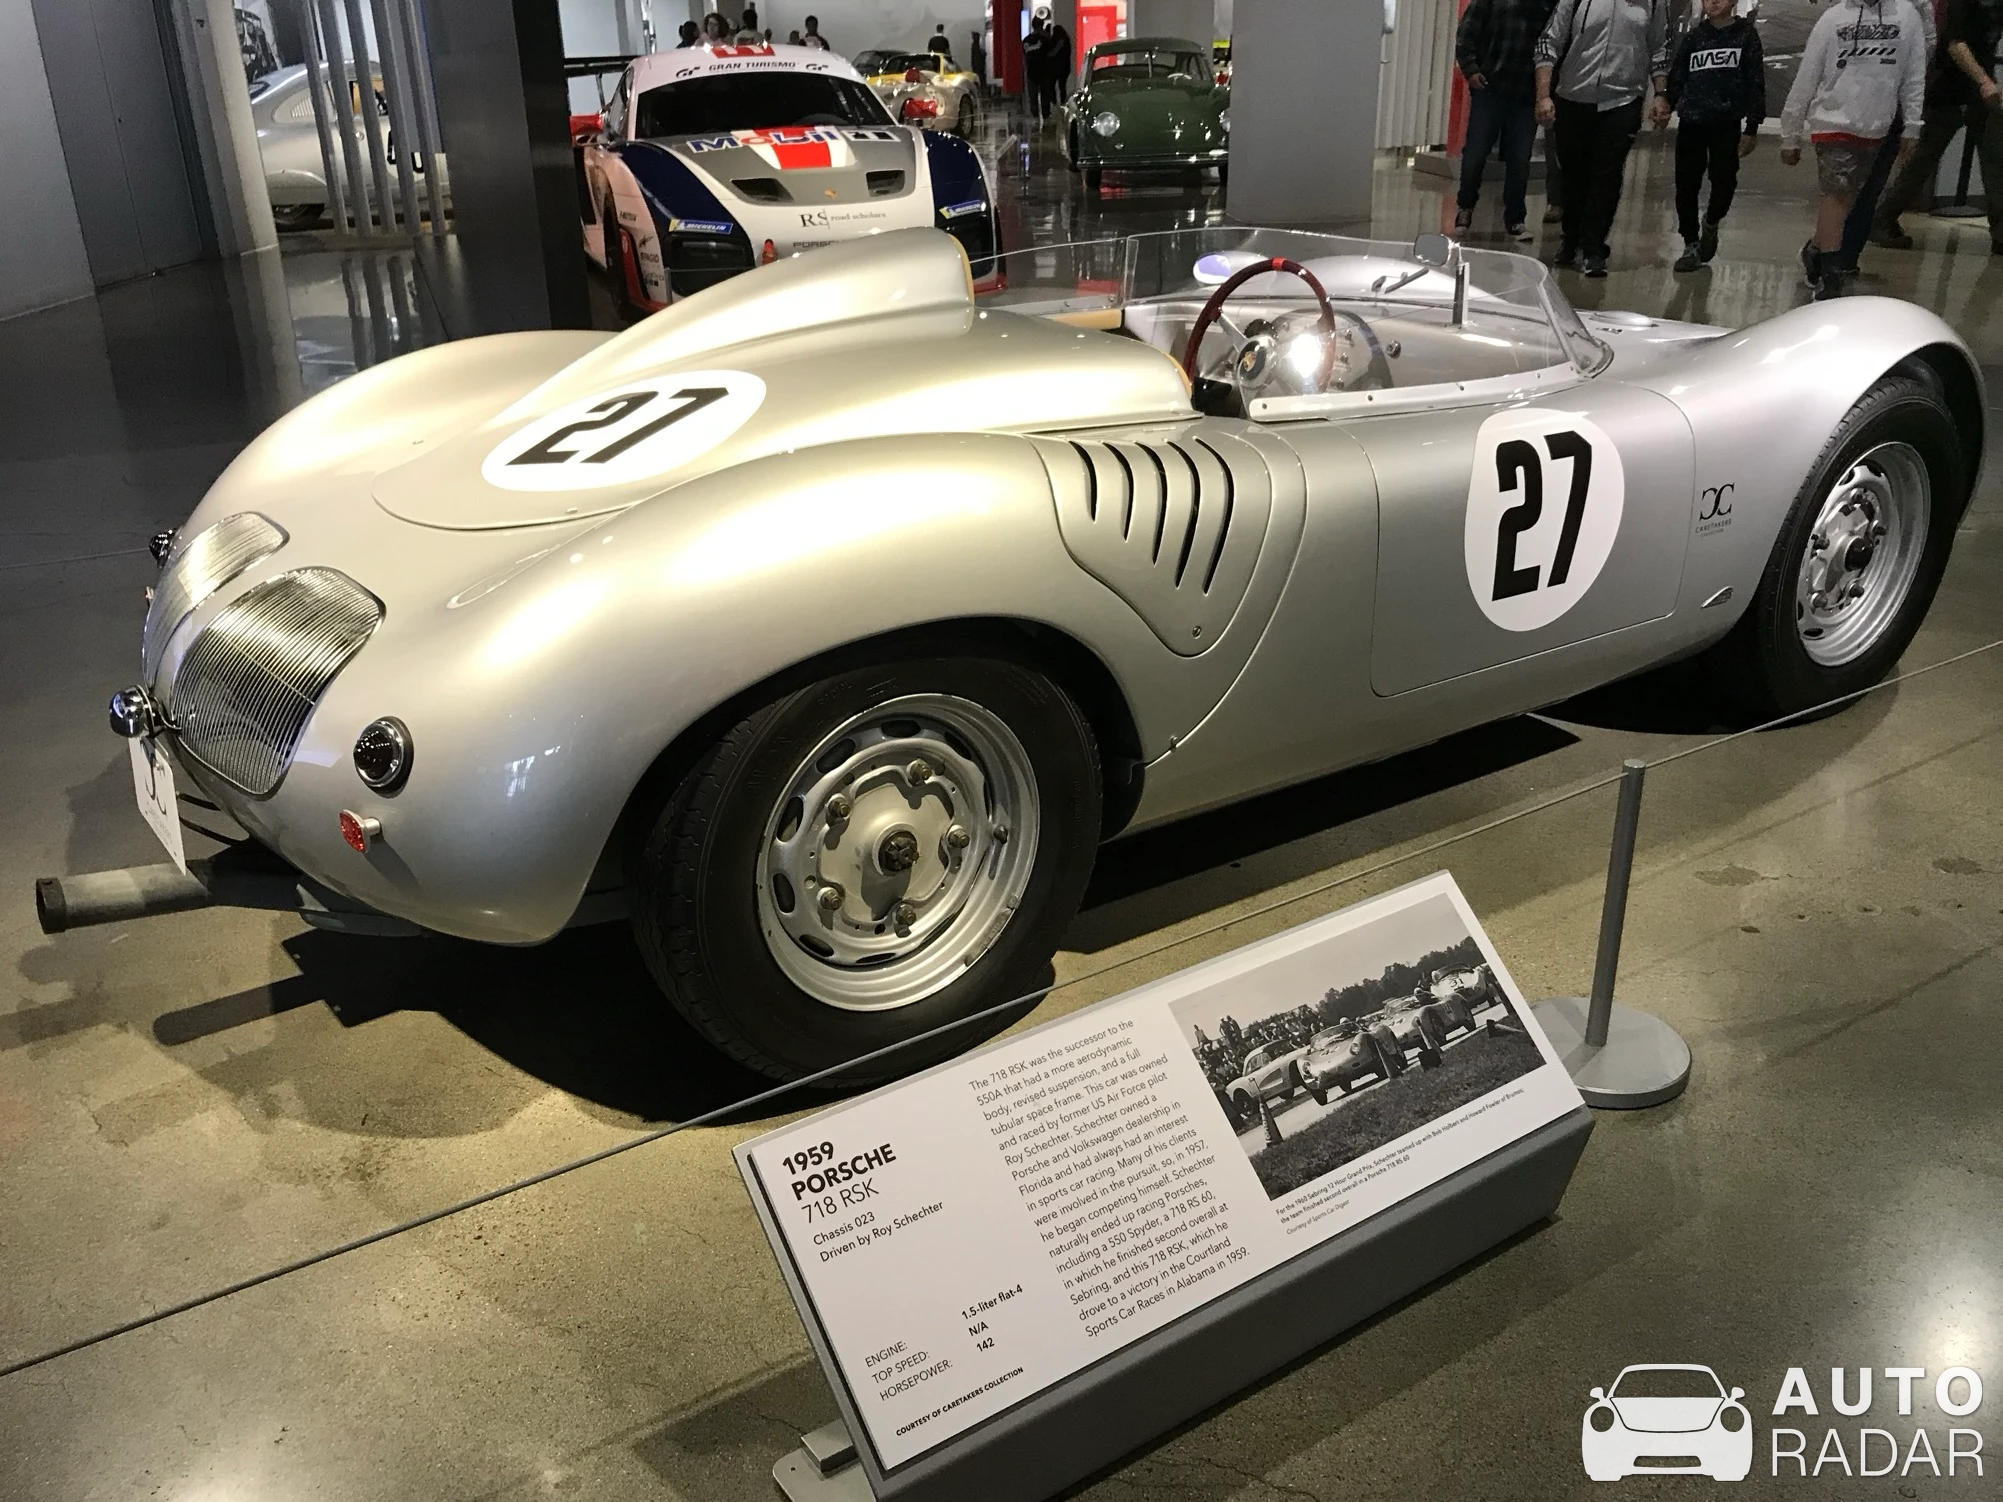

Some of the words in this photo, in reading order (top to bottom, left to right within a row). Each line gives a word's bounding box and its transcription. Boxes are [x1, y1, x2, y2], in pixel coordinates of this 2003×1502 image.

[709, 63, 741, 71] GRAN
[1690, 50, 1738, 70] NASA
[686, 222, 726, 231] MICHELIN
[831, 212, 850, 220] road
[852, 211, 886, 220] scholars
[505, 387, 730, 466] 27
[1492, 430, 1592, 602] 27
[968, 1079, 989, 1091] The
[989, 1068, 1008, 1083] 718
[1007, 1060, 1029, 1076] RSK
[1028, 1055, 1047, 1068] was
[1047, 1048, 1063, 1060] the
[1064, 1030, 1107, 1053] successor
[1107, 1026, 1118, 1036] to
[1117, 1020, 1134, 1031] the
[976, 1088, 1004, 1106] 550A
[1002, 1081, 1023, 1095] that
[1021, 1071, 1042, 1087] had
[1050, 1060, 1075, 1076] more
[1076, 1037, 1132, 1065] aerodynamic
[982, 1104, 1012, 1121] body,
[1012, 1086, 1047, 1109] revised
[1047, 1068, 1100, 1095] suspension,
[1100, 1056, 1119, 1072] and
[1125, 1047, 1141, 1061] full
[990, 1115, 1025, 1136] tubular
[1025, 1104, 1054, 1122] space
[1053, 1092, 1084, 1109] frame.
[1082, 1082, 1104, 1095] This
[1104, 1075, 1119, 1087] car
[1119, 1068, 1138, 1081] was
[1138, 1052, 1168, 1073] owned
[998, 1134, 1018, 1151] and
[1018, 1121, 1046, 1142] raced
[1045, 1119, 1059, 1130] by
[1058, 1105, 1090, 1124] former
[1090, 1096, 1106, 1110] US
[1106, 1092, 1120, 1104] Air
[1119, 1082, 1147, 1098] Force
[1146, 1071, 1168, 1089] pilot
[782, 1141, 834, 1175] 1959
[1004, 1152, 1024, 1166] Roy
[1023, 1131, 1073, 1157] Schechter.
[1072, 1110, 1118, 1136] Schechter
[1119, 1094, 1150, 1116] owned
[1011, 1159, 1050, 1181] Porsche
[1051, 1147, 1070, 1164] and
[1068, 1126, 1125, 1154] Volkswagen
[1125, 1105, 1171, 1131] dealership
[1170, 1101, 1181, 1110] in
[1018, 1175, 1054, 1197] Florida
[1054, 1163, 1073, 1181] and
[1072, 1155, 1093, 1172] had
[1093, 1144, 1124, 1163] always
[1122, 1133, 1142, 1149] had
[1142, 1130, 1155, 1141] an
[1154, 1114, 1189, 1135] interest
[790, 1142, 897, 1201] PORSCHE
[800, 1195, 838, 1224] 718
[838, 1176, 880, 1208] RSK
[1025, 1202, 1037, 1212] in
[1037, 1187, 1069, 1208] sports
[1069, 1179, 1084, 1192] car
[1085, 1166, 1118, 1185] racing.
[1116, 1153, 1143, 1170] Many
[1143, 1144, 1154, 1158] of
[1152, 1141, 1168, 1153] his
[1168, 1128, 1197, 1147] clients
[1033, 1210, 1058, 1227] were
[1057, 1188, 1099, 1215] involved
[1097, 1187, 1109, 1197] in
[1109, 1179, 1126, 1192] the
[1126, 1163, 1161, 1187] pursuit,
[1160, 1157, 1175, 1168] so,
[1173, 1152, 1185, 1161] in
[1184, 1139, 1209, 1156] 1957,
[1039, 1231, 1055, 1243] he
[1053, 1216, 1087, 1236] began
[1087, 1192, 1138, 1221] competing
[1136, 1172, 1173, 1197] himself.
[1171, 1154, 1215, 1180] Schechter
[1306, 1186, 1329, 1200] Sebring
[1346, 1167, 1363, 1180] Grand
[813, 1222, 854, 1246] Chassis
[854, 1211, 875, 1228] 023
[819, 1241, 856, 1263] Driven
[855, 1233, 871, 1246] by
[871, 1224, 892, 1239] Roy
[892, 1201, 943, 1229] Schechter
[1048, 1232, 1089, 1258] naturally
[1090, 1215, 1121, 1238] ended
[1121, 1211, 1135, 1223] up
[1135, 1197, 1166, 1216] racing
[1163, 1178, 1208, 1202] Porsches,
[1054, 1247, 1101, 1274] including
[1107, 1231, 1127, 1248] 550
[1126, 1217, 1163, 1239] Spyder,
[1168, 1202, 1187, 1218] 718
[1186, 1195, 1201, 1210] RS
[1200, 1190, 1216, 1203] 60,
[1062, 1279, 1074, 1290] in
[1074, 1263, 1103, 1284] which
[1101, 1258, 1117, 1270] he
[1116, 1237, 1154, 1263] finished
[1154, 1220, 1188, 1245] second
[1188, 1205, 1218, 1228] overall
[1218, 1202, 1229, 1213] at
[1069, 1281, 1112, 1305] Sebring,
[1112, 1266, 1131, 1285] and
[1130, 1260, 1149, 1275] this
[1147, 1249, 1167, 1266] 718
[1165, 1239, 1190, 1257] RSK,
[1188, 1226, 1216, 1246] which
[1214, 1221, 1229, 1233] he
[1078, 1302, 1107, 1321] drove
[1106, 1296, 1119, 1307] to
[1126, 1275, 1159, 1296] victory
[1158, 1270, 1170, 1280] in
[1169, 1261, 1186, 1275] the
[1185, 1235, 1232, 1266] Courtland
[1084, 1315, 1119, 1337] Sports
[1118, 1305, 1136, 1320] Car
[1136, 1291, 1166, 1311] Races
[1164, 1286, 1176, 1296] in
[1176, 1265, 1219, 1291] Alabama
[1214, 1260, 1229, 1274] in
[1225, 1246, 1252, 1268] 1959.
[961, 1297, 998, 1320] 1.5-liter
[997, 1283, 1023, 1302] flat-4
[968, 1320, 989, 1337] N/A
[864, 1340, 908, 1368] ENGINE:
[870, 1366, 893, 1384] TOP
[894, 1350, 930, 1373] SPEED:
[976, 1337, 995, 1352] 142
[879, 1359, 953, 1402] HORSEPOWER:
[895, 1413, 931, 1437] COURTESY
[931, 1408, 942, 1418] OF
[942, 1386, 984, 1413] CARETAKERS
[983, 1366, 1024, 1391] COLLECTION
